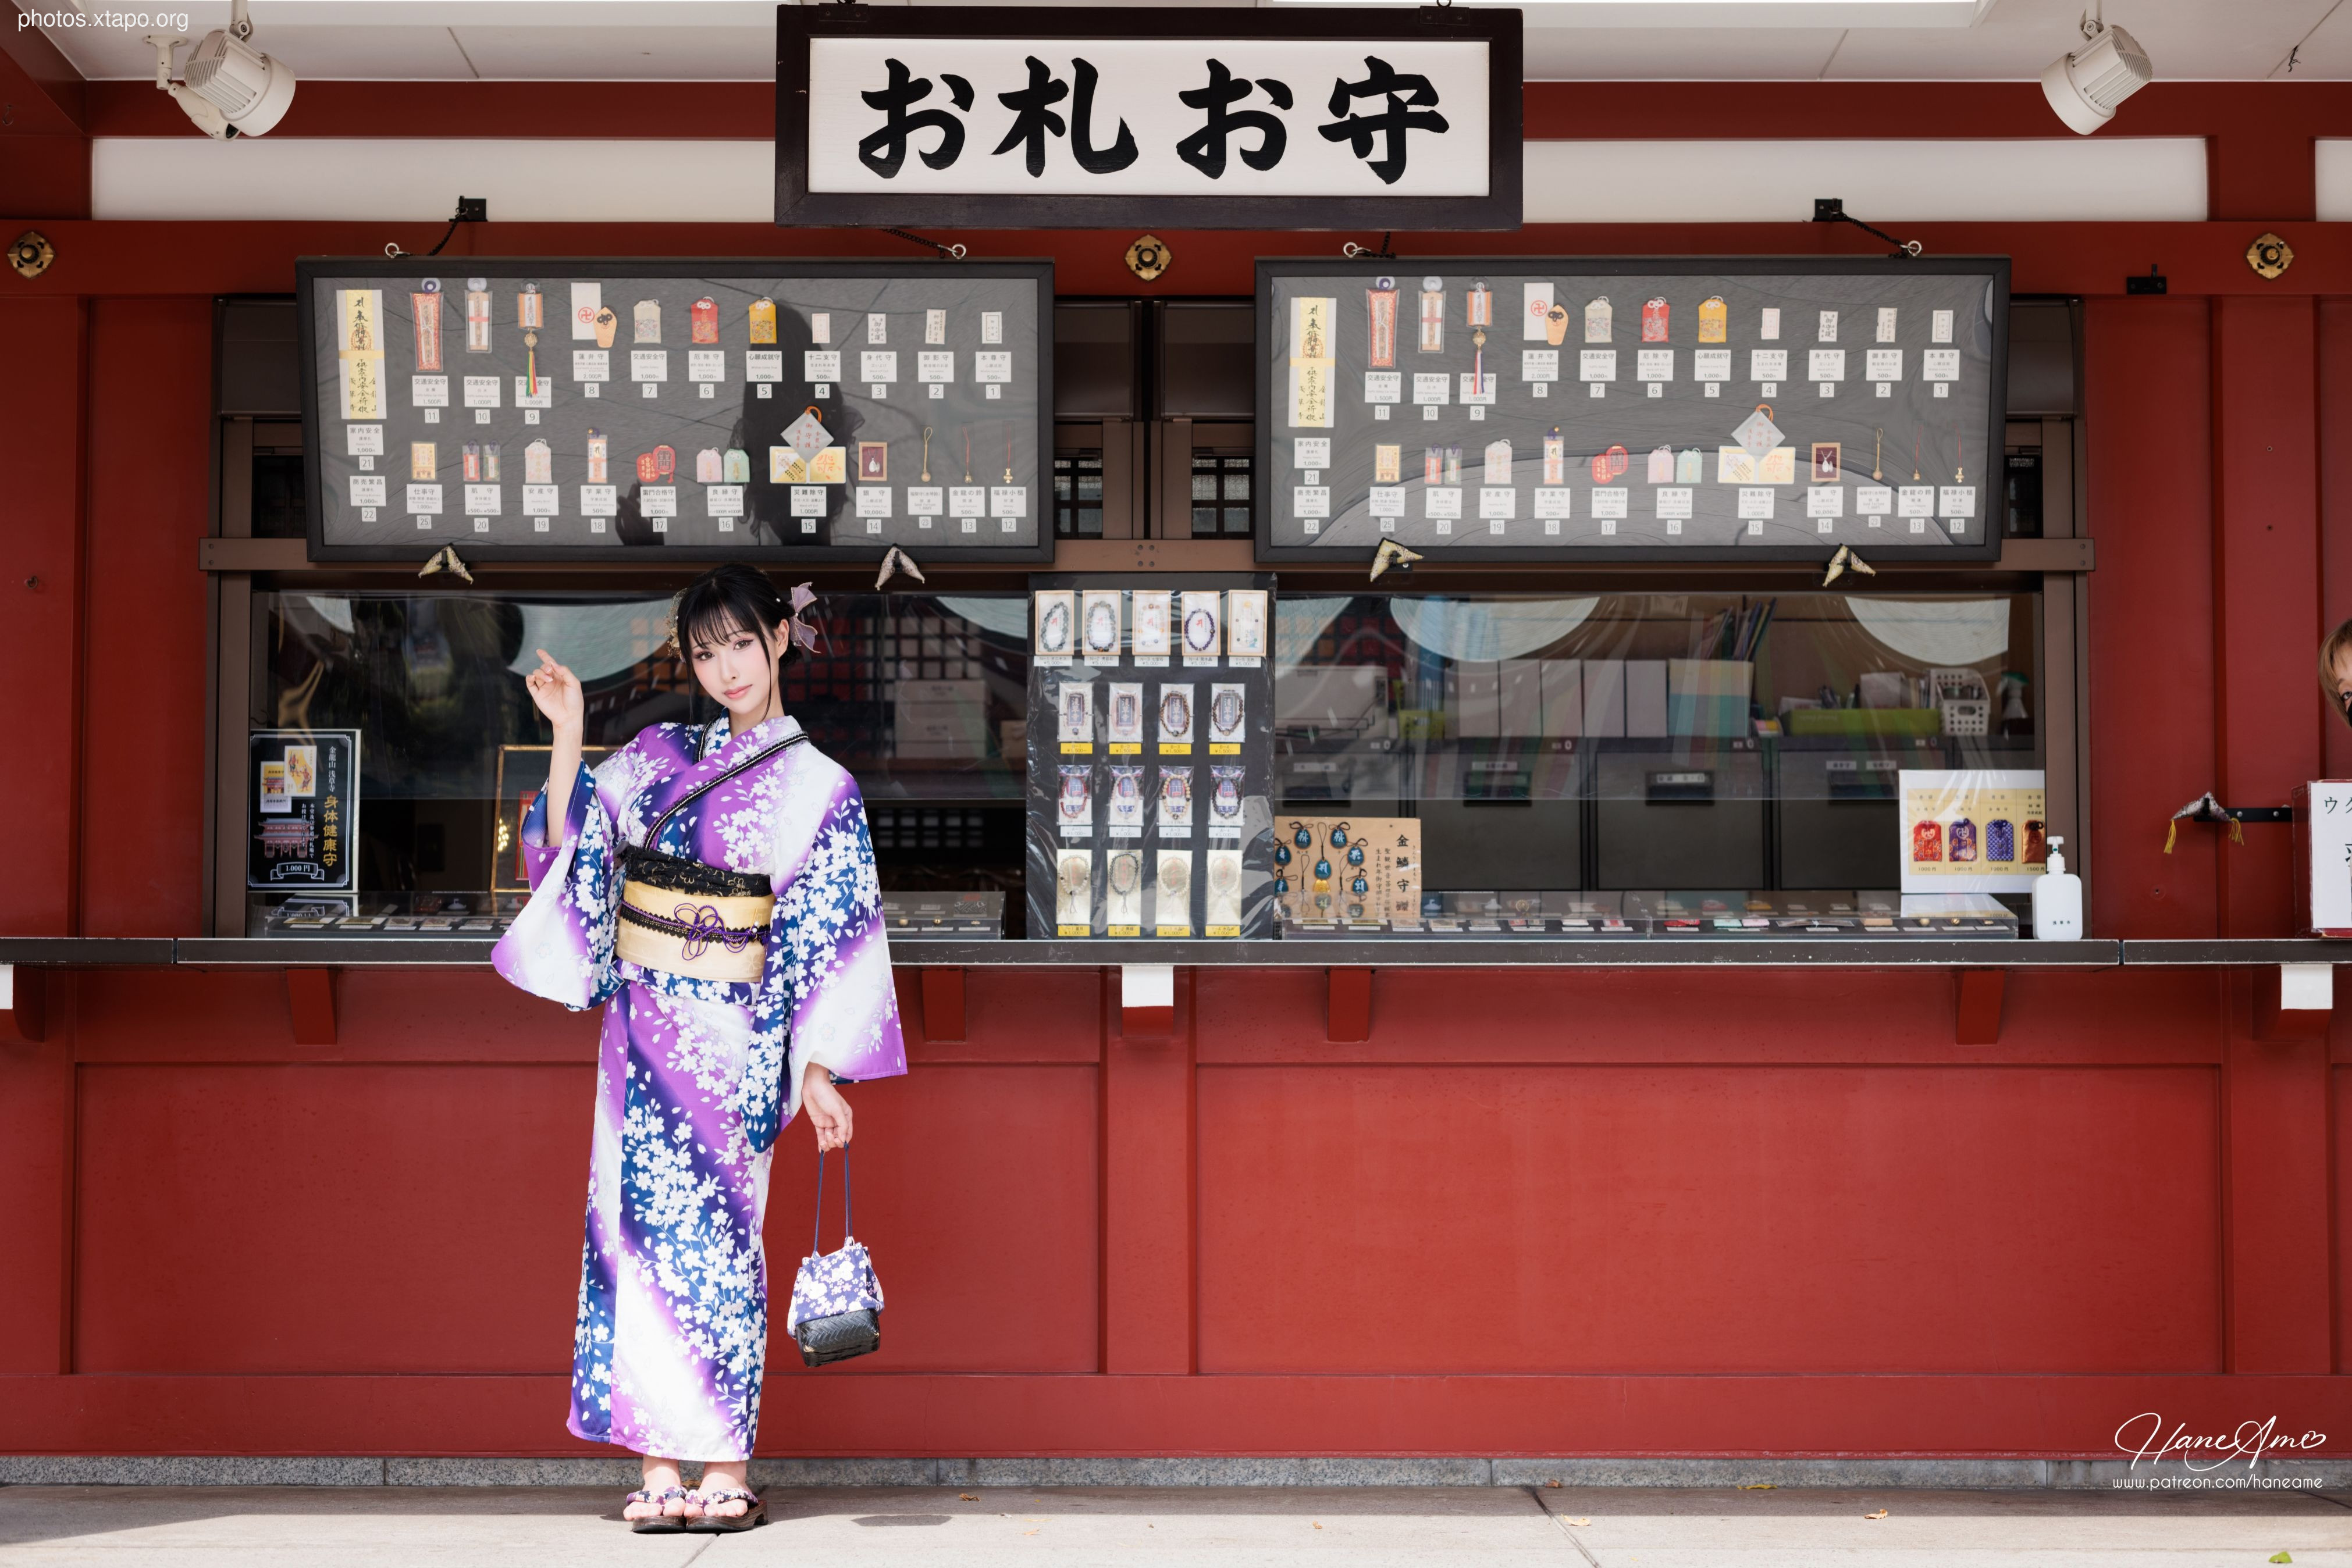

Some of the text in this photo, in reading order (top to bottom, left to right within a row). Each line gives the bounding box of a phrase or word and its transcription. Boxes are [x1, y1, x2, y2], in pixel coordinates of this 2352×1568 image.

[859, 55, 1450, 185] お札お守
[323, 794, 339, 867] 身体健康守
